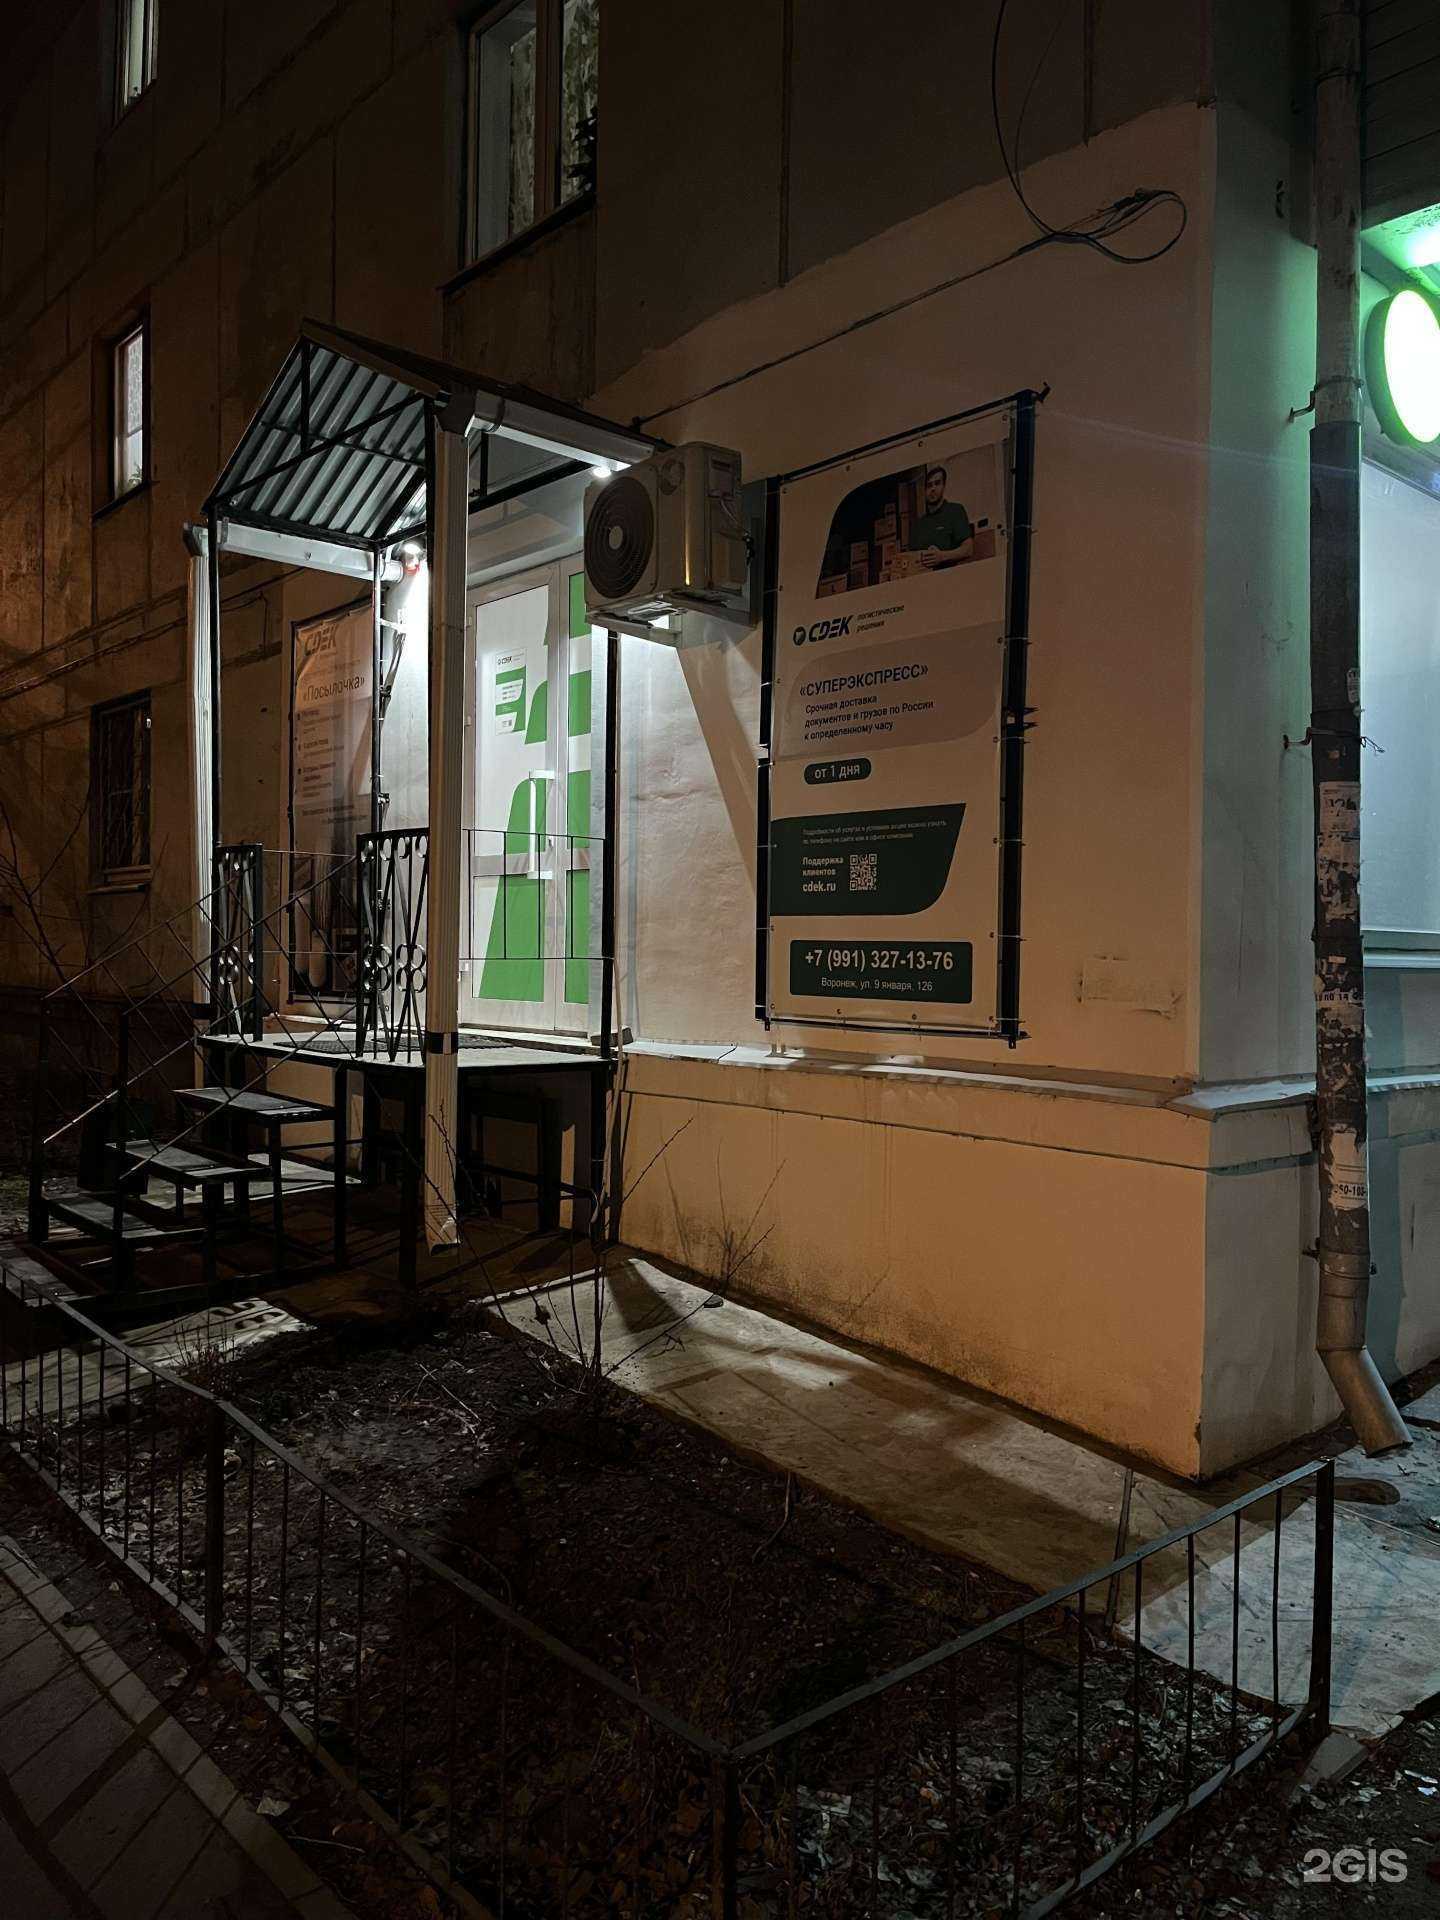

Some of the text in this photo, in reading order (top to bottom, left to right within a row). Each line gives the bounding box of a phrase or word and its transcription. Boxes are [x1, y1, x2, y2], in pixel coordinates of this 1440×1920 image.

[809, 615, 854, 643] CDEK
[800, 664, 928, 696] «СУПЕРЭКСПРЕСС»
[805, 695, 878, 715] Срочная доставка
[805, 712, 851, 728] документов
[860, 707, 888, 721] грузов
[889, 705, 901, 715] по
[902, 701, 934, 713] России
[804, 720, 894, 742] к определенному часу
[814, 768, 827, 779] от
[839, 764, 861, 779] дня
[803, 856, 844, 867] Поддержка
[803, 867, 836, 877] клиентов
[803, 880, 836, 892] cdek.ru
[805, 949, 954, 972] +7 (991) 327-13-76
[874, 979, 880, 989] 9
[917, 981, 933, 991] 126
